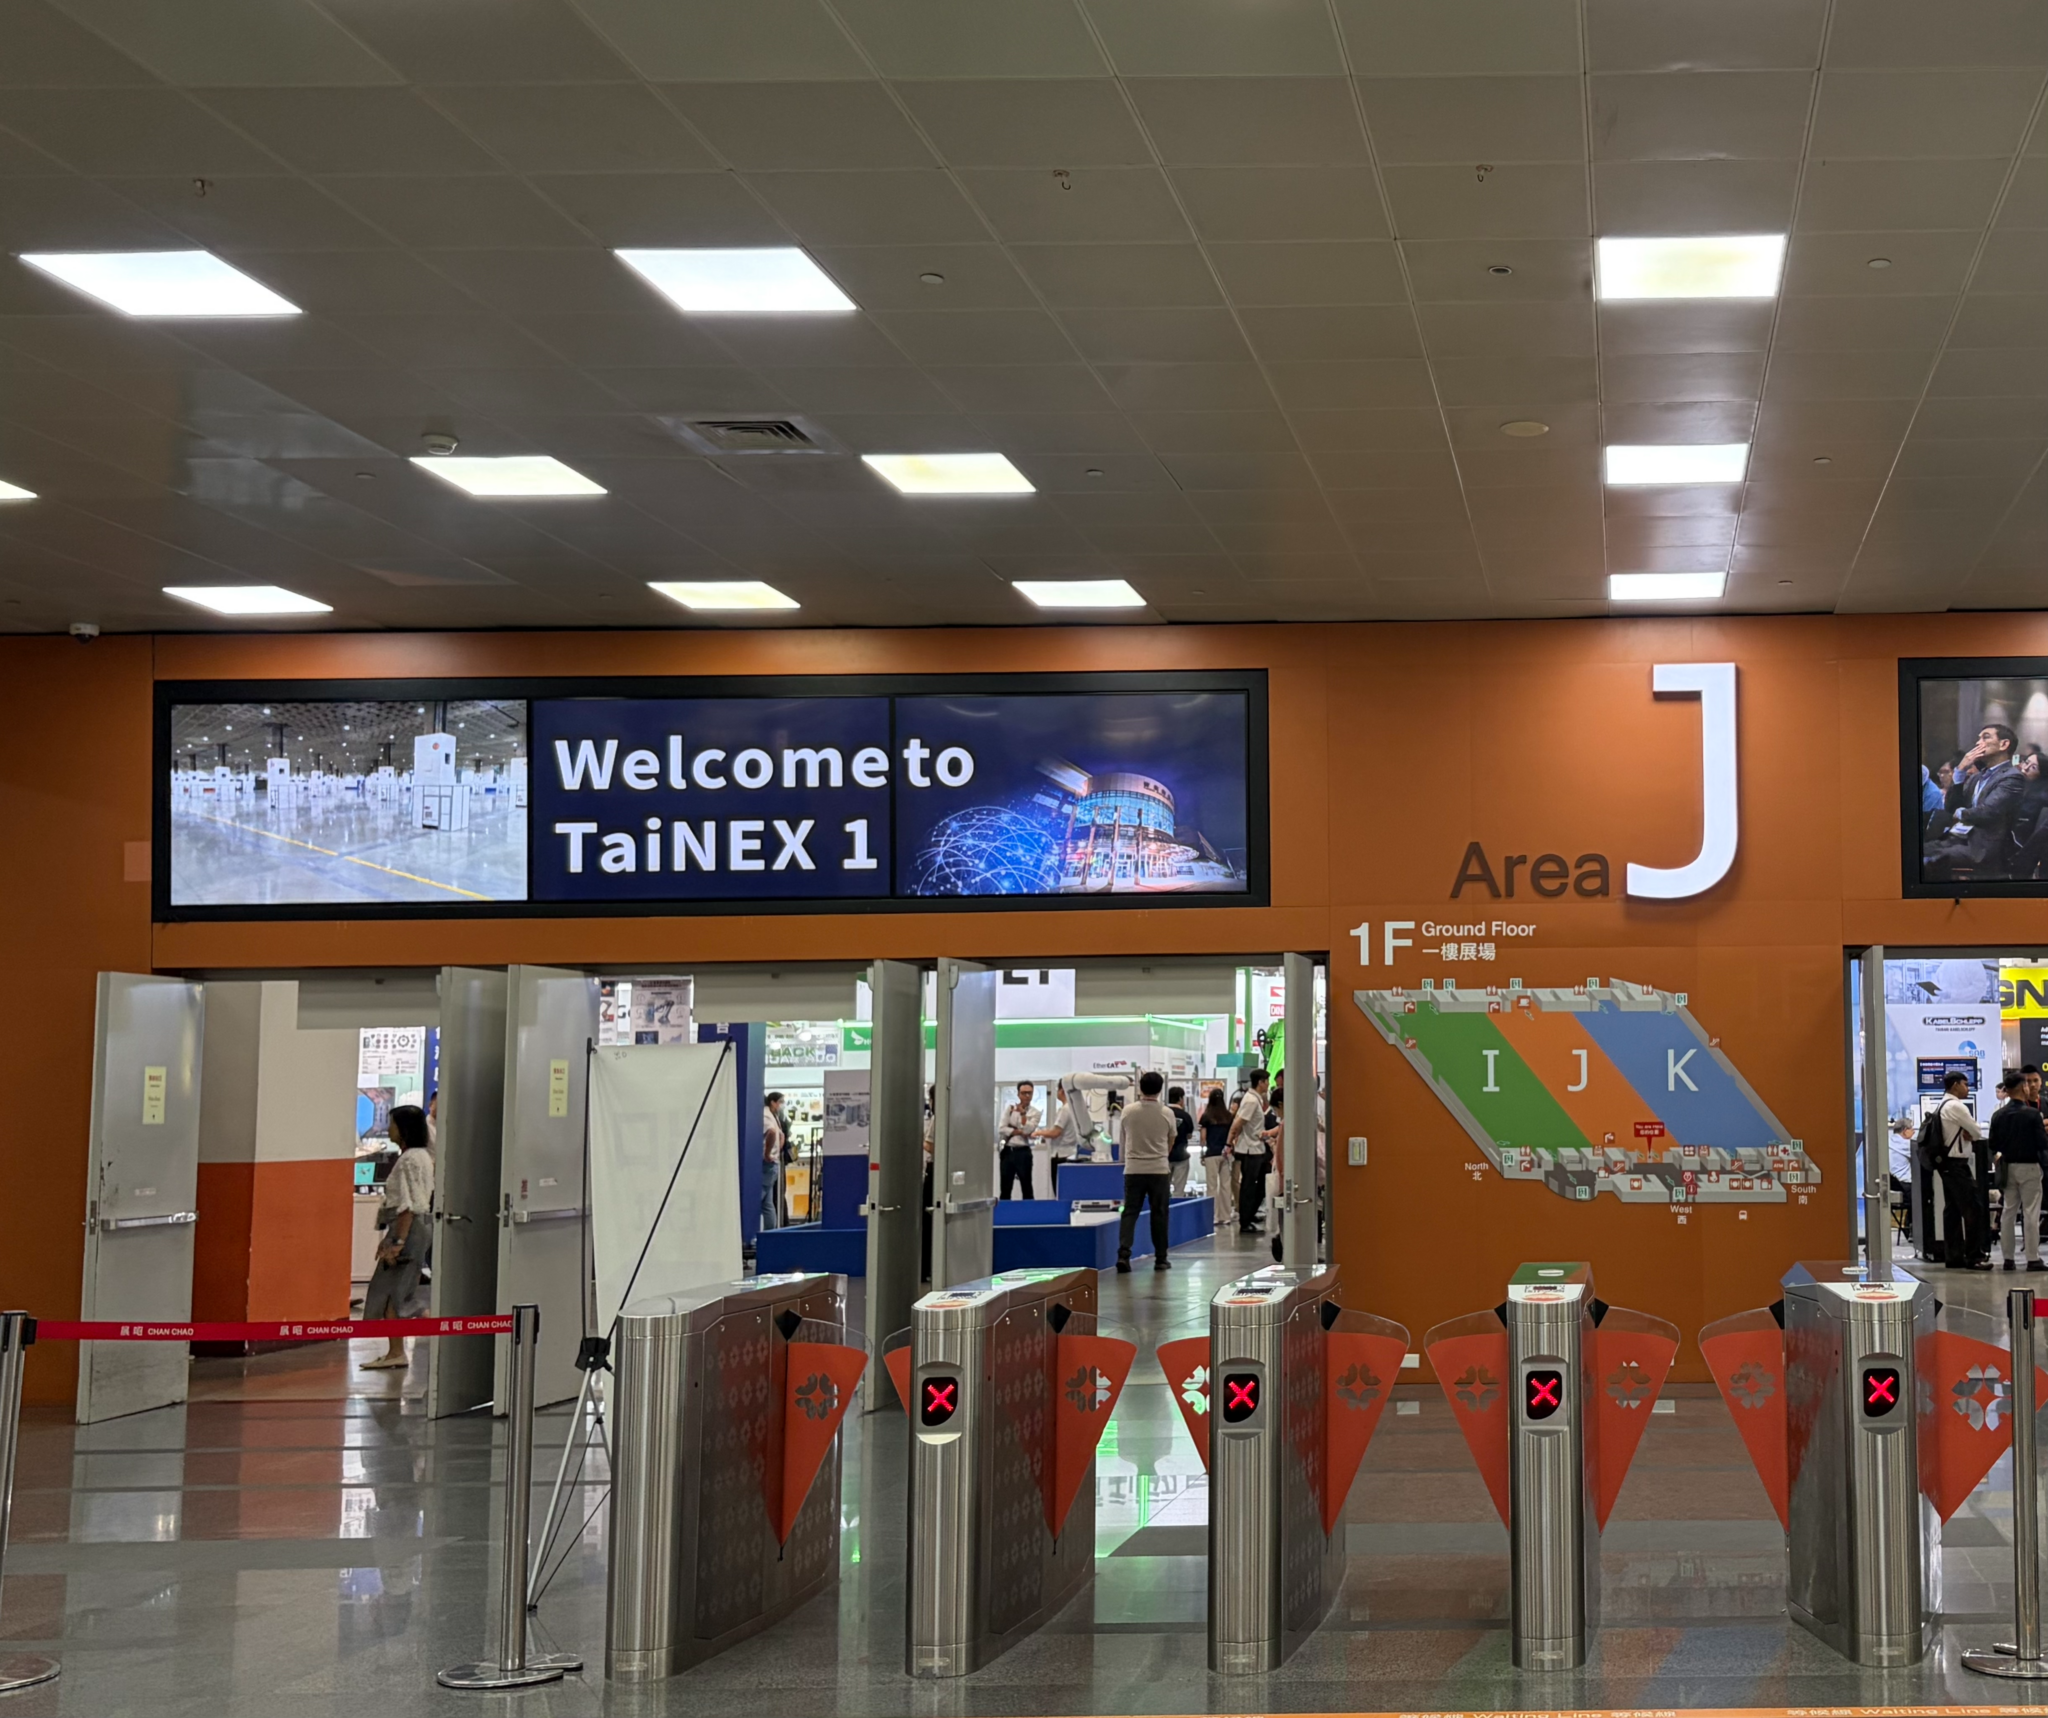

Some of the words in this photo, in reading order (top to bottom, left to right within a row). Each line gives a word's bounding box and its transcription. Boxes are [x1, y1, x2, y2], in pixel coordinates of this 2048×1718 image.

[554, 735, 890, 791] Welcome
[903, 738, 975, 787] to
[1450, 842, 1609, 898] Area
[1627, 662, 1738, 898] J
[554, 817, 816, 873] TaiNEX
[843, 819, 878, 869] 1
[1421, 921, 1486, 937] Ground
[1491, 921, 1536, 937] Floor
[1350, 921, 1415, 966] 1F
[1422, 942, 1496, 962] 一樓展場
[1482, 1049, 1500, 1092] I
[1567, 1049, 1588, 1092] J
[1667, 1048, 1699, 1092] K
[1464, 1162, 1489, 1171] North
[1472, 1171, 1482, 1181] 北
[1791, 1184, 1817, 1194] South
[1670, 1204, 1693, 1214] West
[147, 1327, 170, 1336] CHAN
[171, 1327, 194, 1336] CHAO
[307, 1326, 330, 1334] CHAN
[331, 1325, 354, 1334] CHAO
[467, 1321, 490, 1329] CHAN
[1860, 1708, 1938, 1716] Waiting
